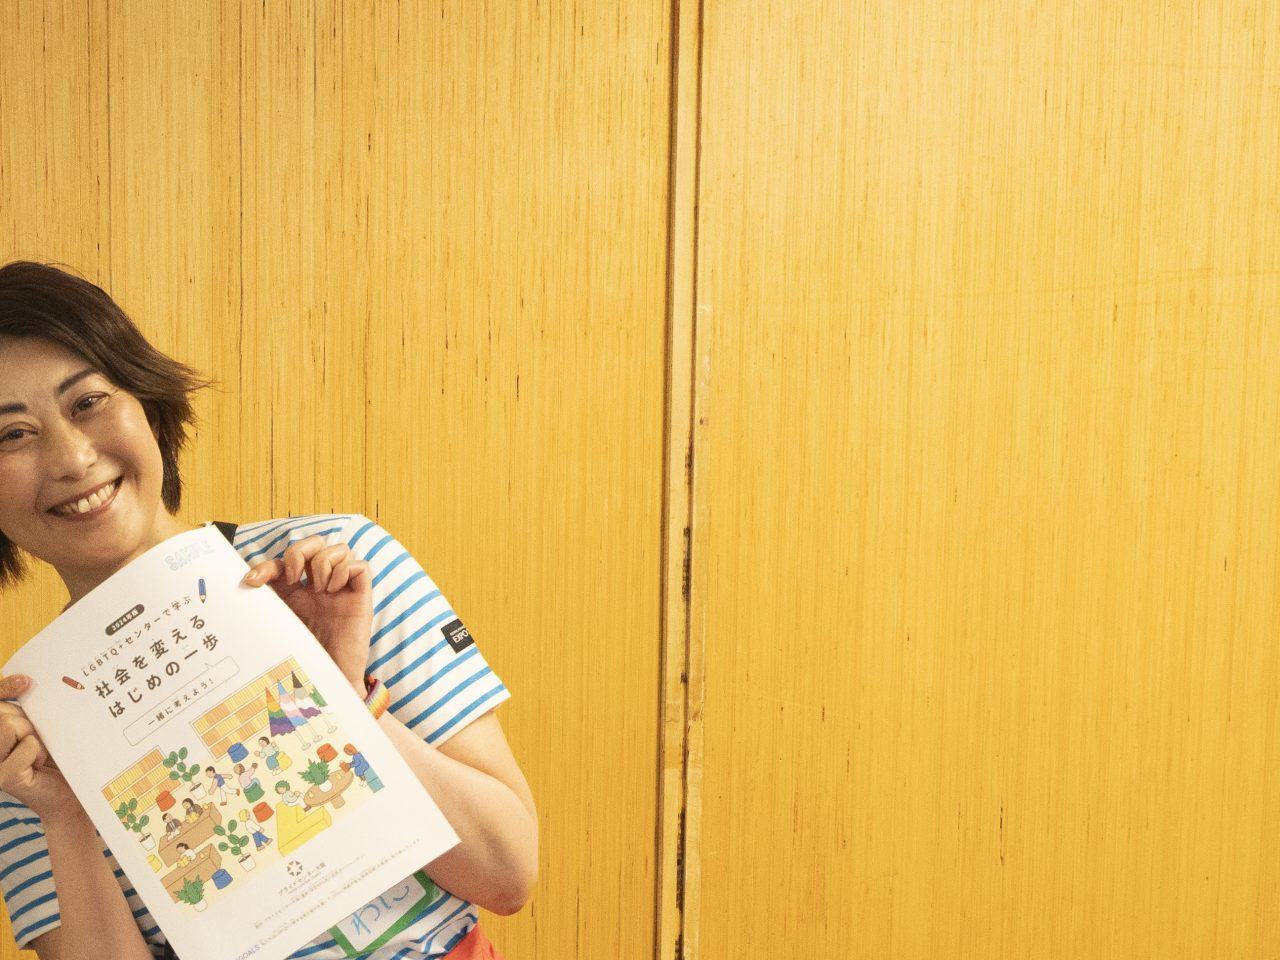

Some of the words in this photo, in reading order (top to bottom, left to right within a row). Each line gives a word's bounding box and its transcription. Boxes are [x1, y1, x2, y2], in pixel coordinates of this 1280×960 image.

[95, 614, 206, 699] 社会を変える
[108, 632, 220, 719] はじめの一歩
